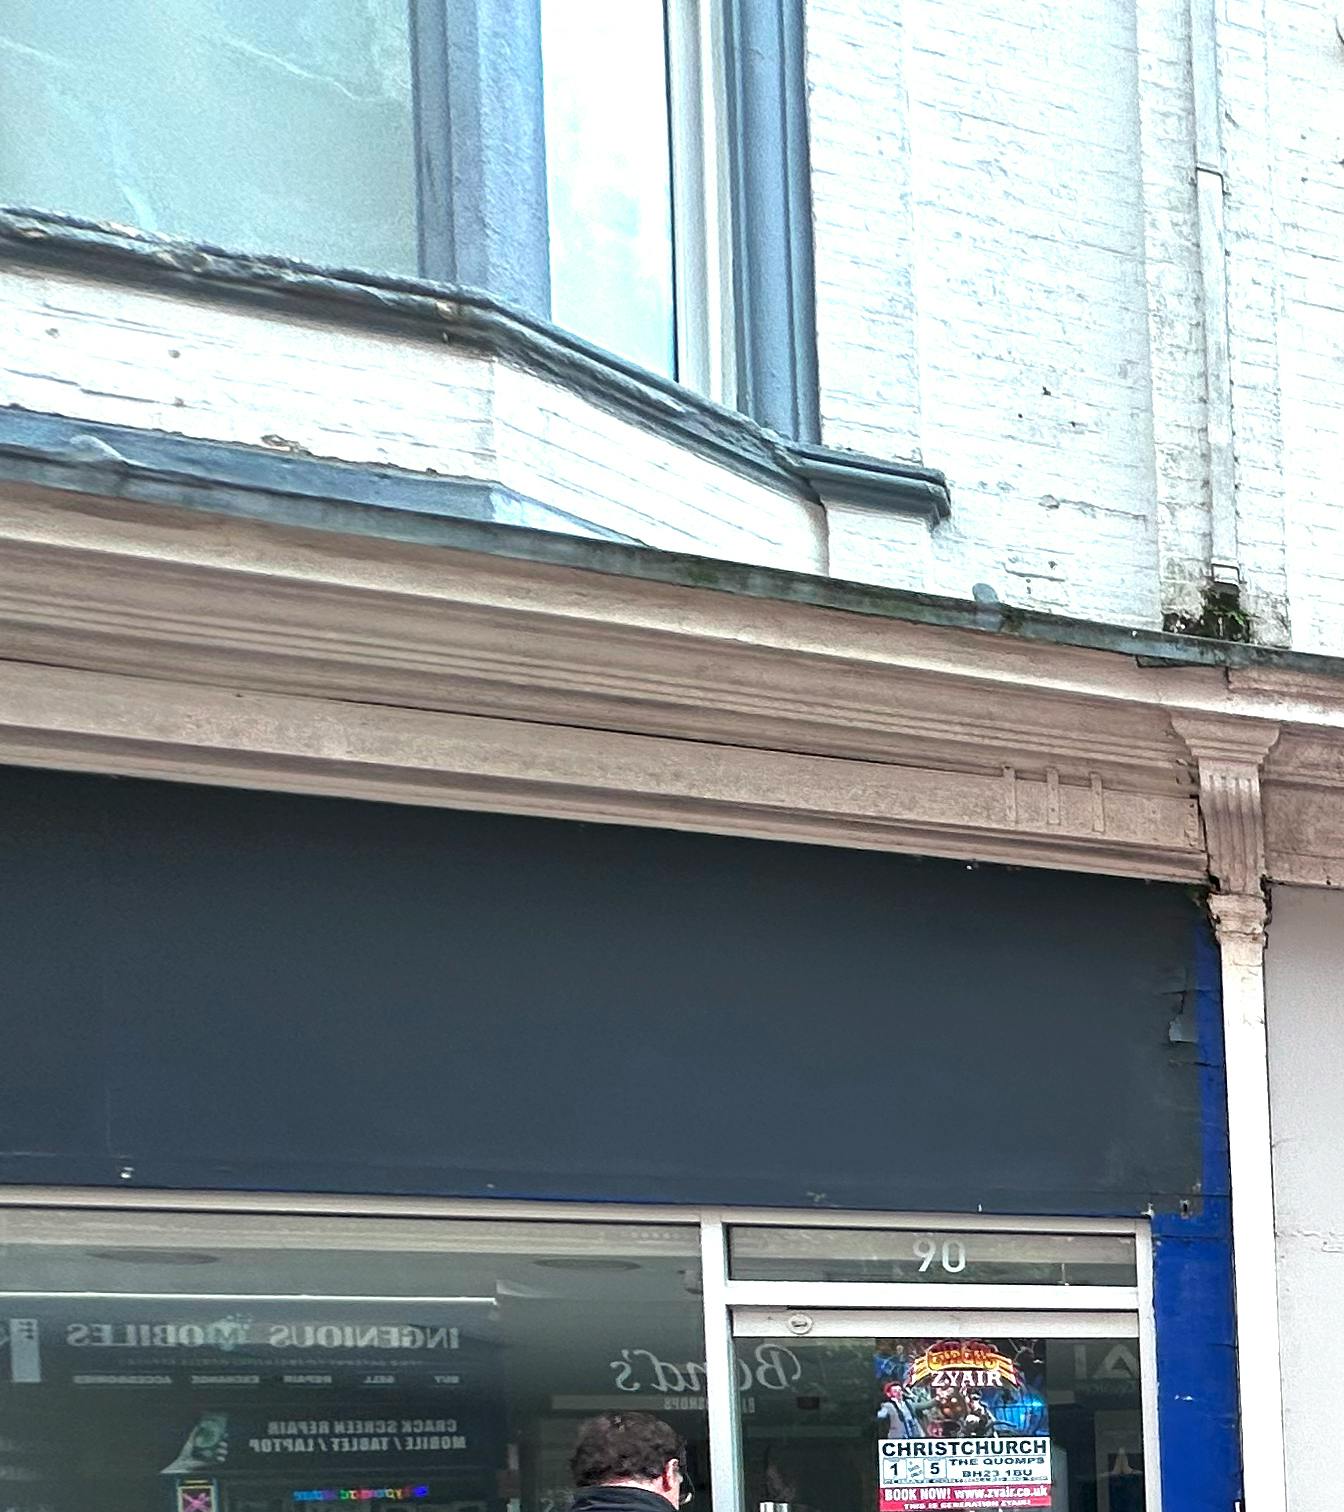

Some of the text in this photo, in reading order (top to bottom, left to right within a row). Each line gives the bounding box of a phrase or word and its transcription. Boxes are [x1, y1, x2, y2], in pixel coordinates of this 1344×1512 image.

[913, 1239, 966, 1273] 90
[931, 1370, 1003, 1387] ZYAIR
[882, 1439, 1047, 1457] CHRISTCHURCH
[890, 1463, 898, 1476] 1
[930, 1462, 940, 1475] 5
[949, 1457, 1045, 1466] THE QUOMPS
[884, 1485, 1048, 1501] BOOK NOW! www.zyair.co.uk
